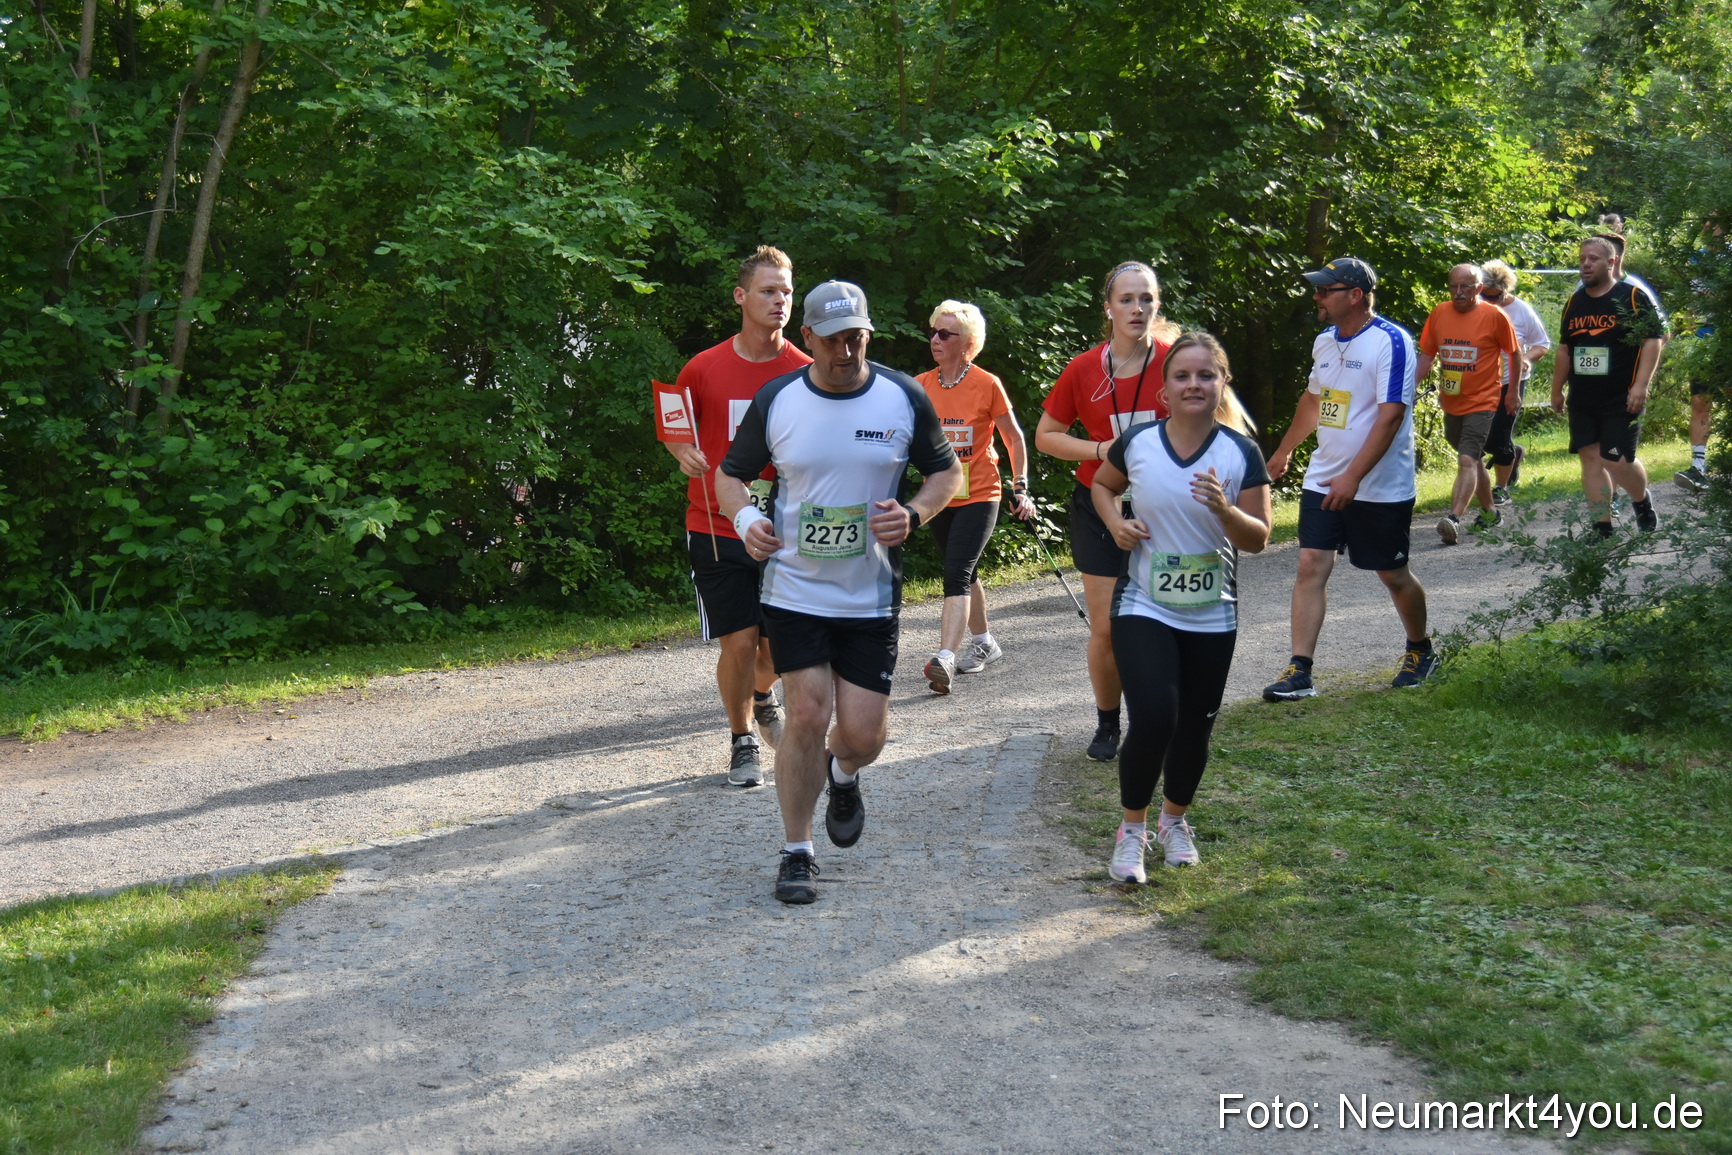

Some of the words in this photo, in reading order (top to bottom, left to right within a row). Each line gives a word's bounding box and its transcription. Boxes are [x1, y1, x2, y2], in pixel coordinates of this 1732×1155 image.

[1574, 315, 1616, 329] WINGS
[1440, 349, 1474, 360] OBI
[1579, 356, 1600, 368] 288
[1321, 401, 1339, 418] 932
[943, 417, 965, 425] Jahre
[855, 429, 884, 440] swn
[942, 430, 969, 443] BI
[750, 494, 770, 512] 93
[804, 523, 859, 545] 2273
[1158, 571, 1214, 593] 2450
